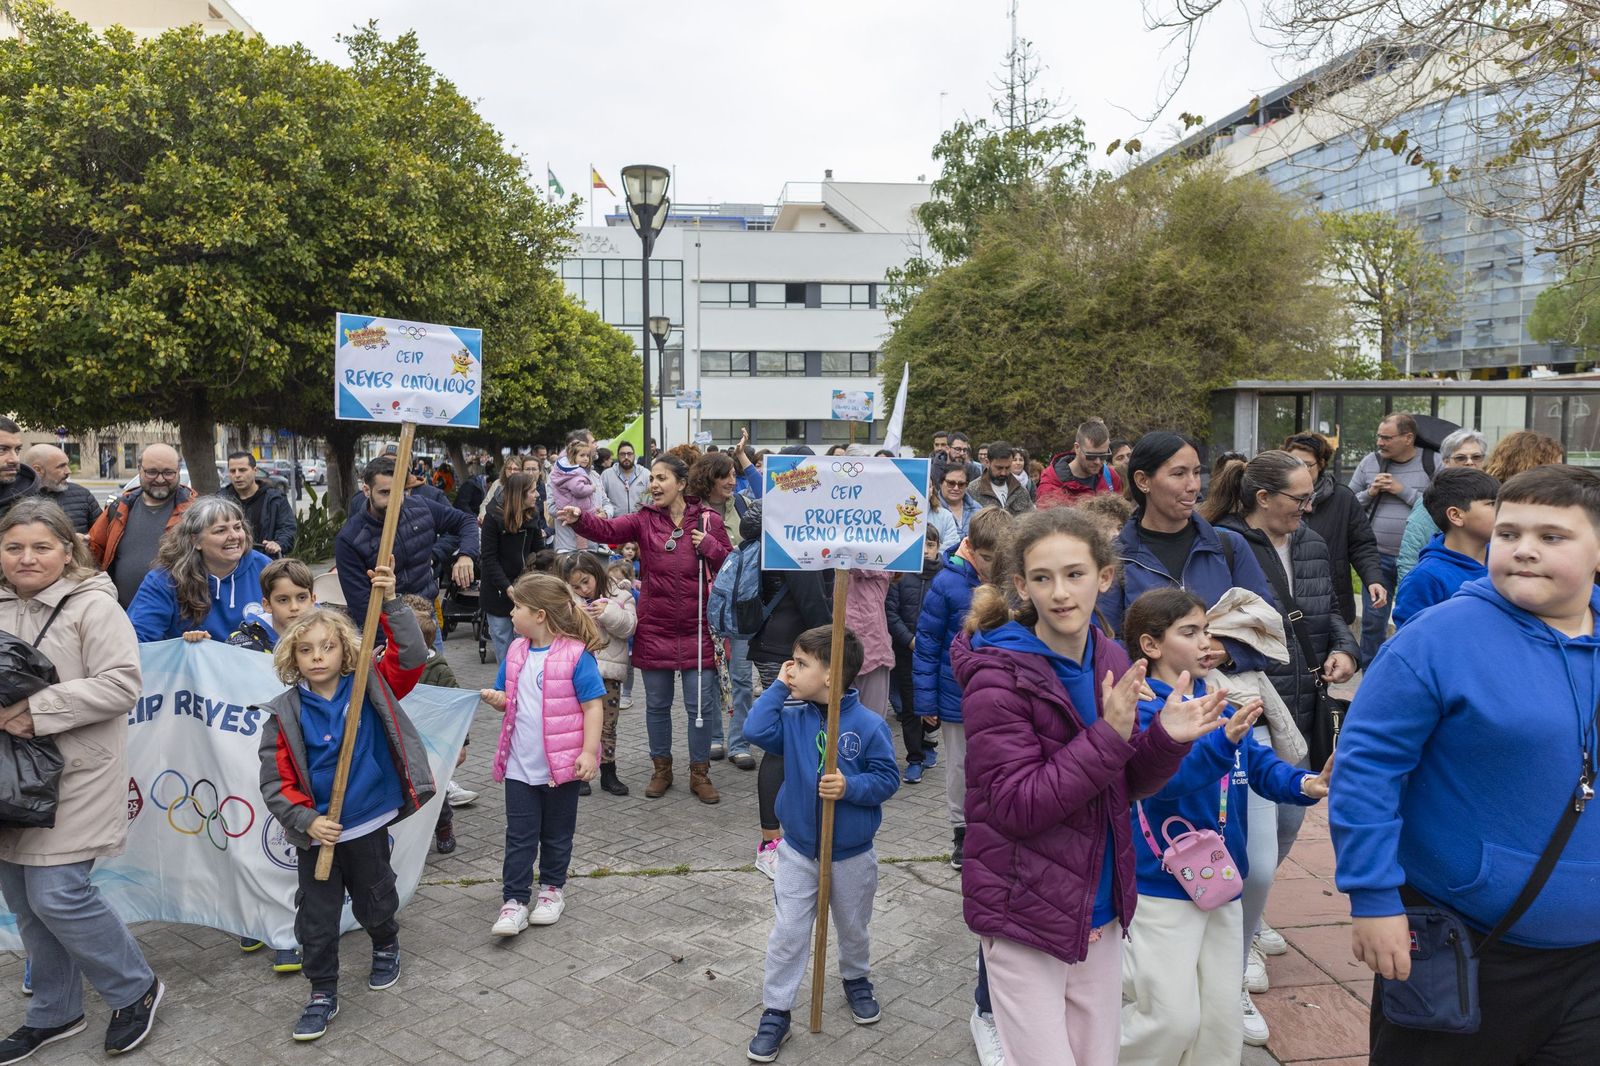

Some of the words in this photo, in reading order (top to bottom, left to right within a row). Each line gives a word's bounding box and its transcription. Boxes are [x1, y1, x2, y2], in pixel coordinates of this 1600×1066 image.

[587, 242, 620, 254] LOCAL
[396, 350, 424, 364] CEIP
[345, 369, 393, 388] REYES
[401, 373, 476, 395] CATÓLICOS
[831, 485, 863, 500] CEIP
[805, 508, 882, 526] PROFESOR
[783, 524, 837, 543] TIERNO
[844, 524, 900, 543] GALVÁN
[174, 689, 262, 736] REYES
